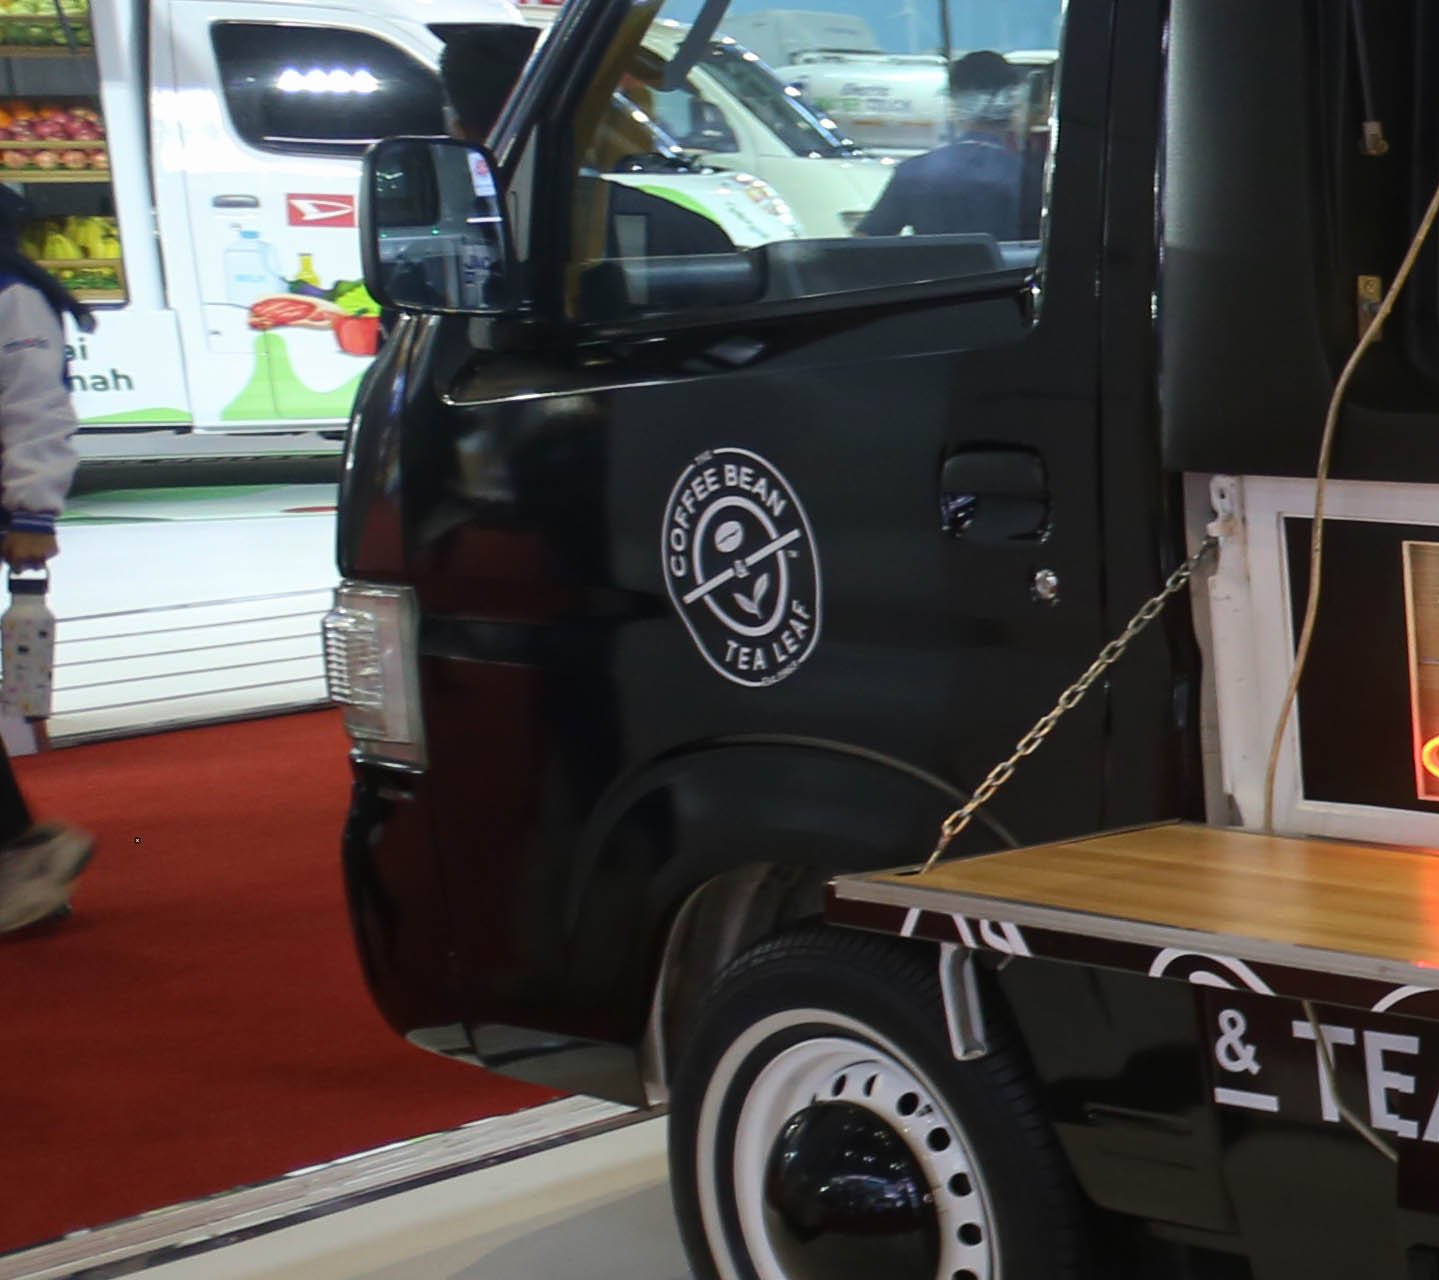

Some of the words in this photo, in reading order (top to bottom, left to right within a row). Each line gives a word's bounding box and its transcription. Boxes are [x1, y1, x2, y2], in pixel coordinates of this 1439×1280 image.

[670, 468, 721, 577] COFFEE
[723, 464, 787, 517] BEAN
[724, 639, 769, 671] TEA
[772, 600, 811, 663] LEAF
